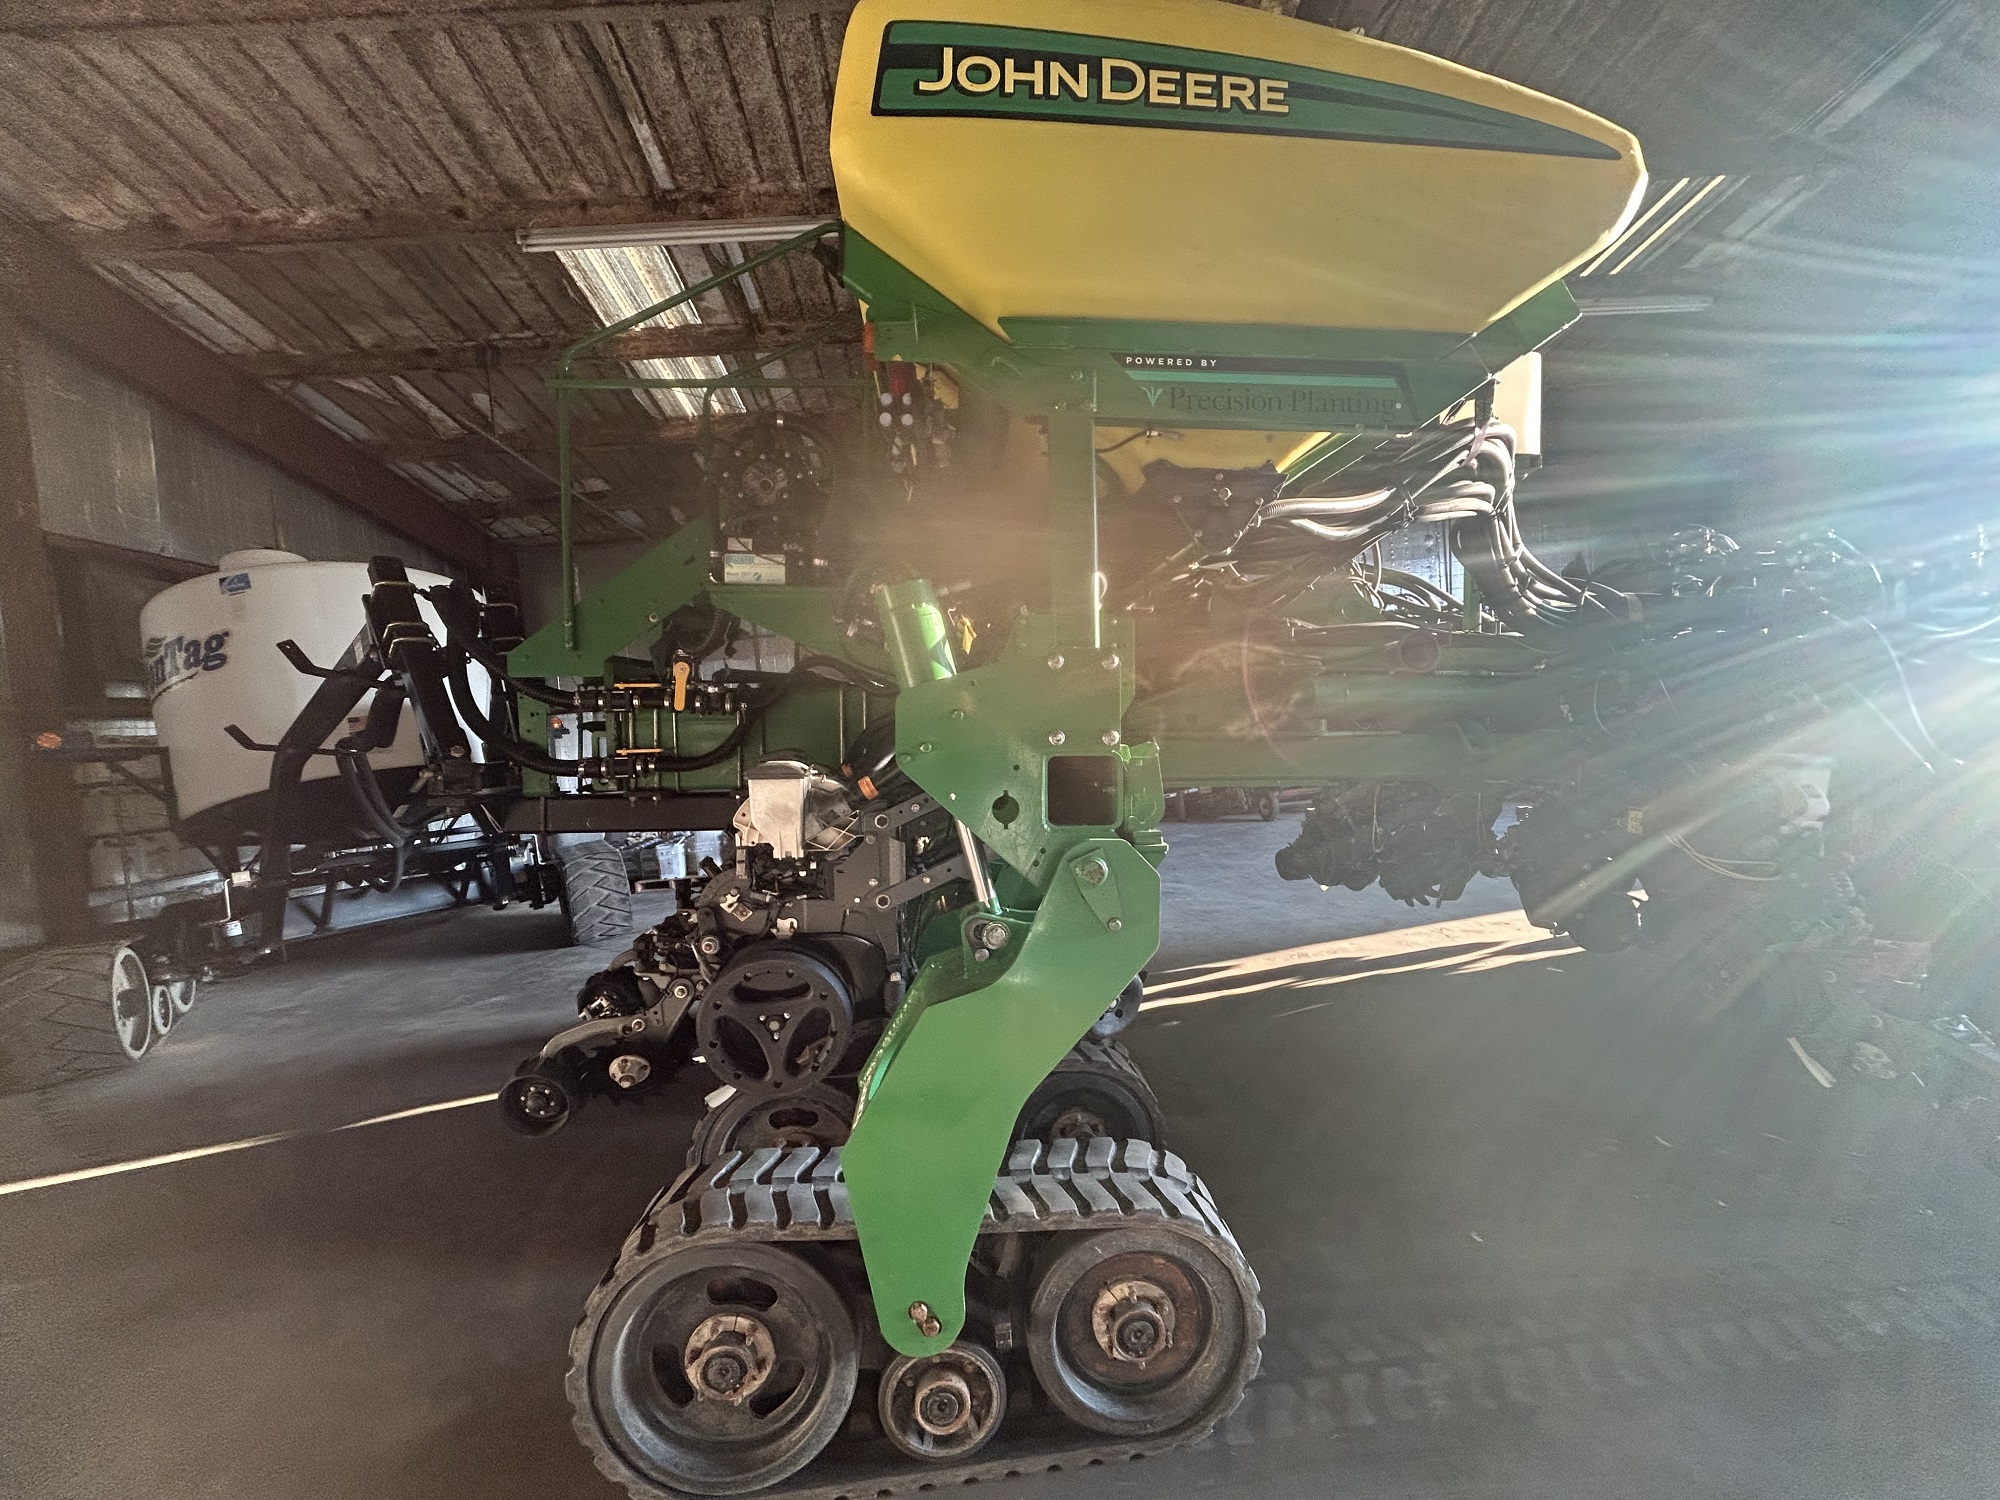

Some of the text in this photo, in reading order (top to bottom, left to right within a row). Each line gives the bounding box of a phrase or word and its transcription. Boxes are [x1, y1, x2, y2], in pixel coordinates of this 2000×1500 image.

[918, 46, 1290, 114] JOHN DEERE
[1125, 356, 1218, 368] POWERED BY
[1169, 386, 1396, 423] Precision Planting
